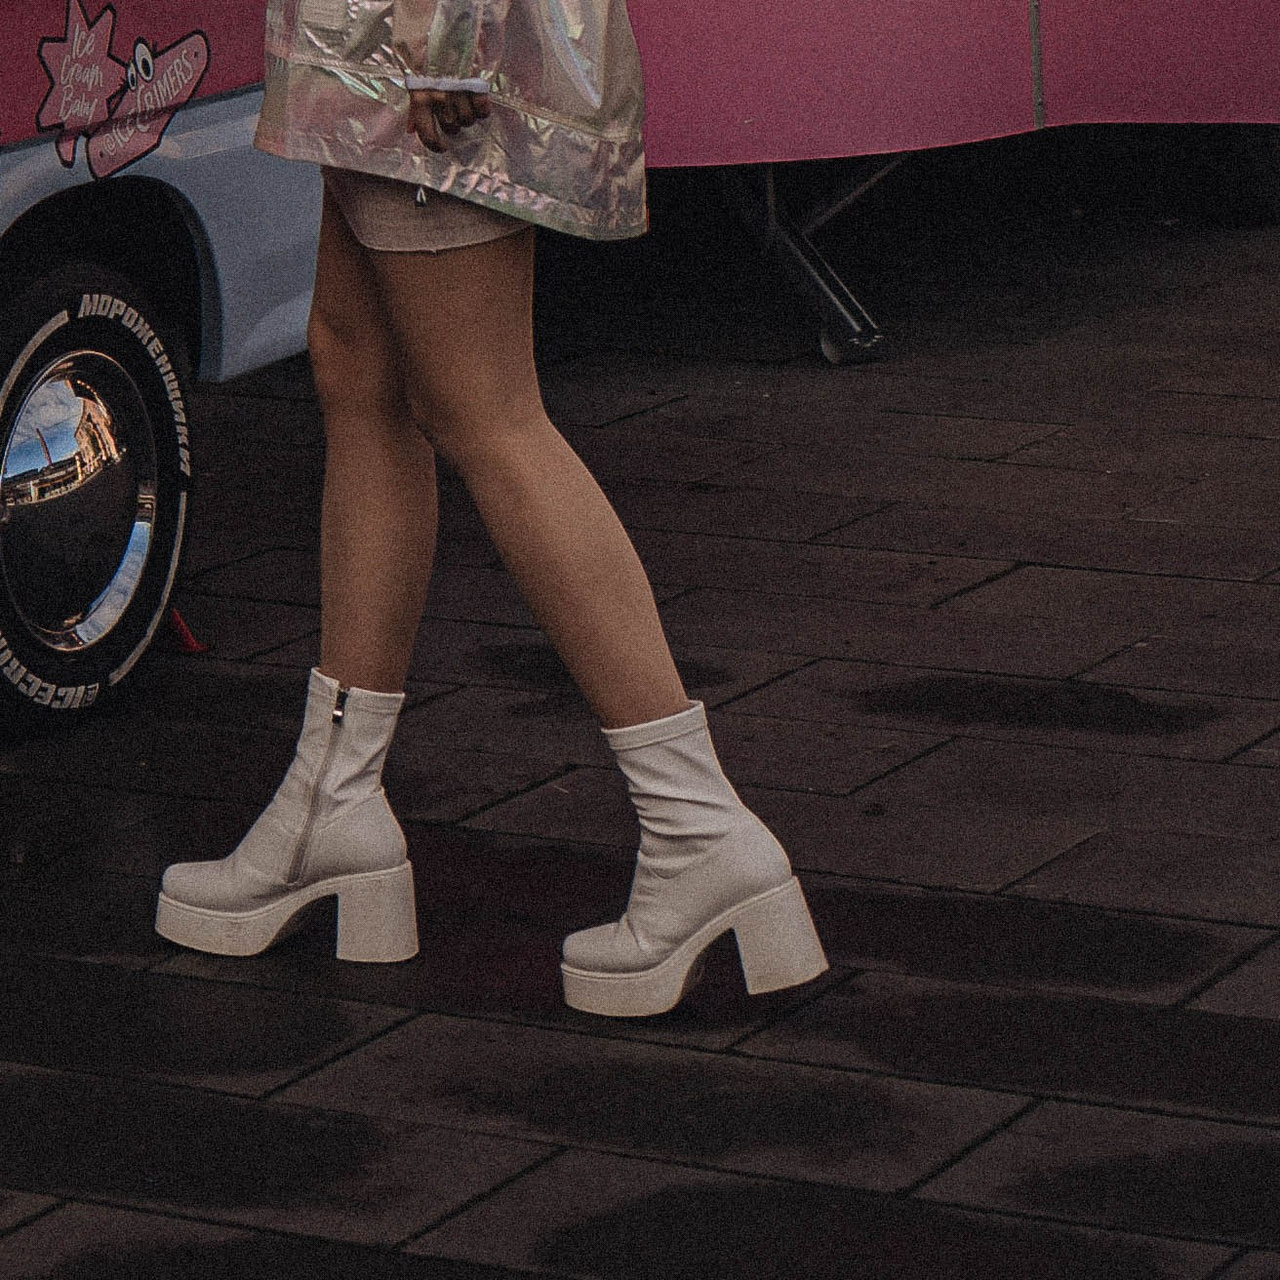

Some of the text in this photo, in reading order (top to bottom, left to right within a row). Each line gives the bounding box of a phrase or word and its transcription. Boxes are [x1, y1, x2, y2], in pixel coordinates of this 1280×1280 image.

[72, 22, 96, 60] Ice
[60, 54, 104, 91] Cream
[58, 84, 99, 125] Baby
[77, 293, 192, 478] МОРОЖЕНЩИКИ
